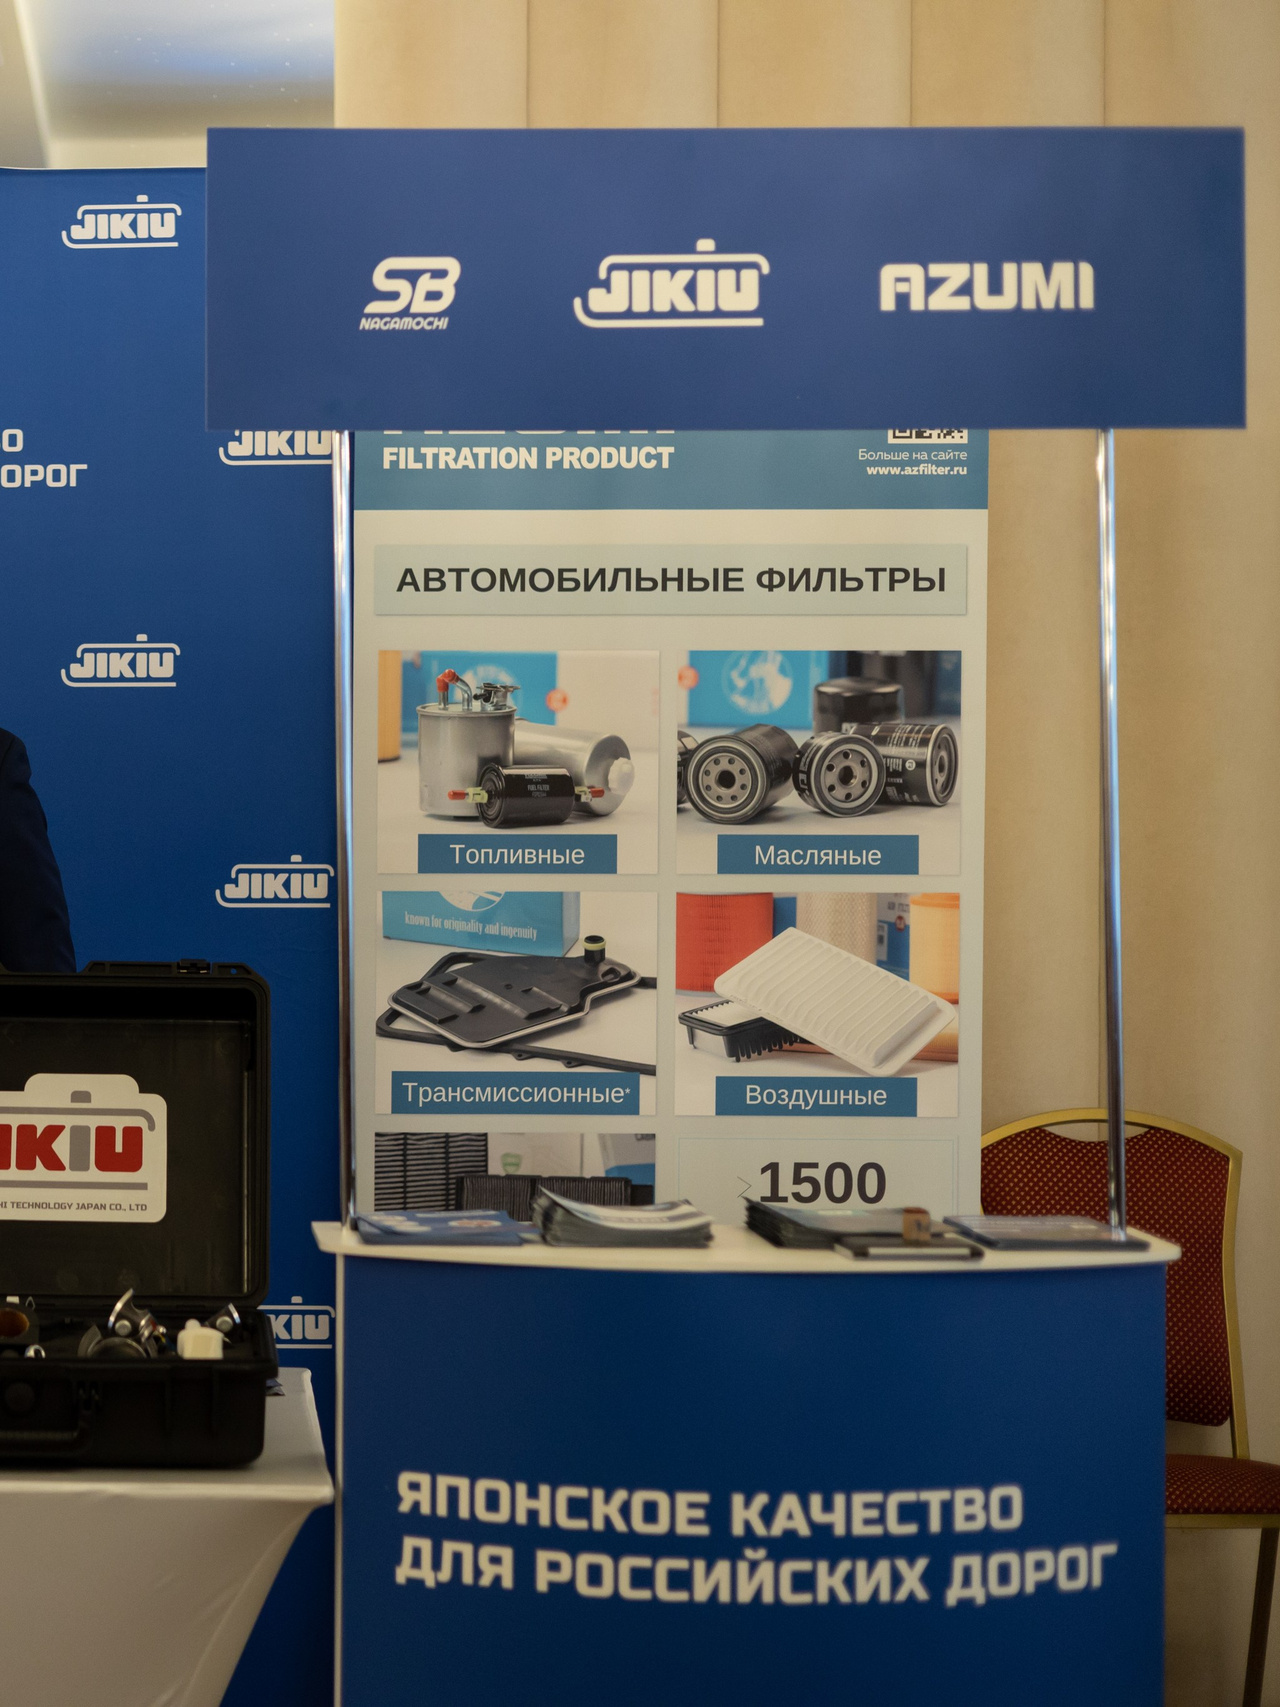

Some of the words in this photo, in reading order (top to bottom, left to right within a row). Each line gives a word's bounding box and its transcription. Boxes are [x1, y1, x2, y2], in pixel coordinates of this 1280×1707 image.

[71, 195, 176, 239] JIKIU
[373, 256, 462, 314] SB
[588, 239, 760, 312] JIKIU
[880, 261, 1095, 312] AZUMI
[359, 315, 449, 331] NAGAMOCHI
[384, 446, 538, 470] FILTRATION
[546, 446, 675, 470] PRODUCT
[858, 448, 910, 461] Больше
[913, 452, 928, 461] на
[931, 449, 968, 461] сайте
[866, 463, 968, 475] www.azfilter.ru
[397, 567, 745, 593] АВТОМОБИЛЬНЫЕ
[756, 567, 946, 593] ФИЛЬТРЫ
[70, 634, 174, 678] JIKIU
[449, 844, 585, 865] Топливные
[755, 844, 882, 866] Масляные
[225, 855, 329, 899] JIKIU
[404, 911, 431, 926] known
[431, 914, 442, 928] for
[444, 918, 483, 935] originality
[484, 923, 499, 934] and
[501, 923, 537, 941] ingenuity
[746, 1085, 887, 1112] Воздушные
[10, 1201, 73, 1210] TECHNOLOGY
[75, 1203, 107, 1211] JAPAN
[109, 1204, 127, 1212] CO.,
[129, 1204, 148, 1212] LTD
[396, 1471, 710, 1536] ЯПОНСКОЕ
[730, 1485, 1023, 1537] КАЧЕСТВО
[395, 1535, 514, 1590] ДЛЯ
[535, 1548, 930, 1604] РОССИЙСКИХ
[946, 1544, 1118, 1607] ДОРОГ
